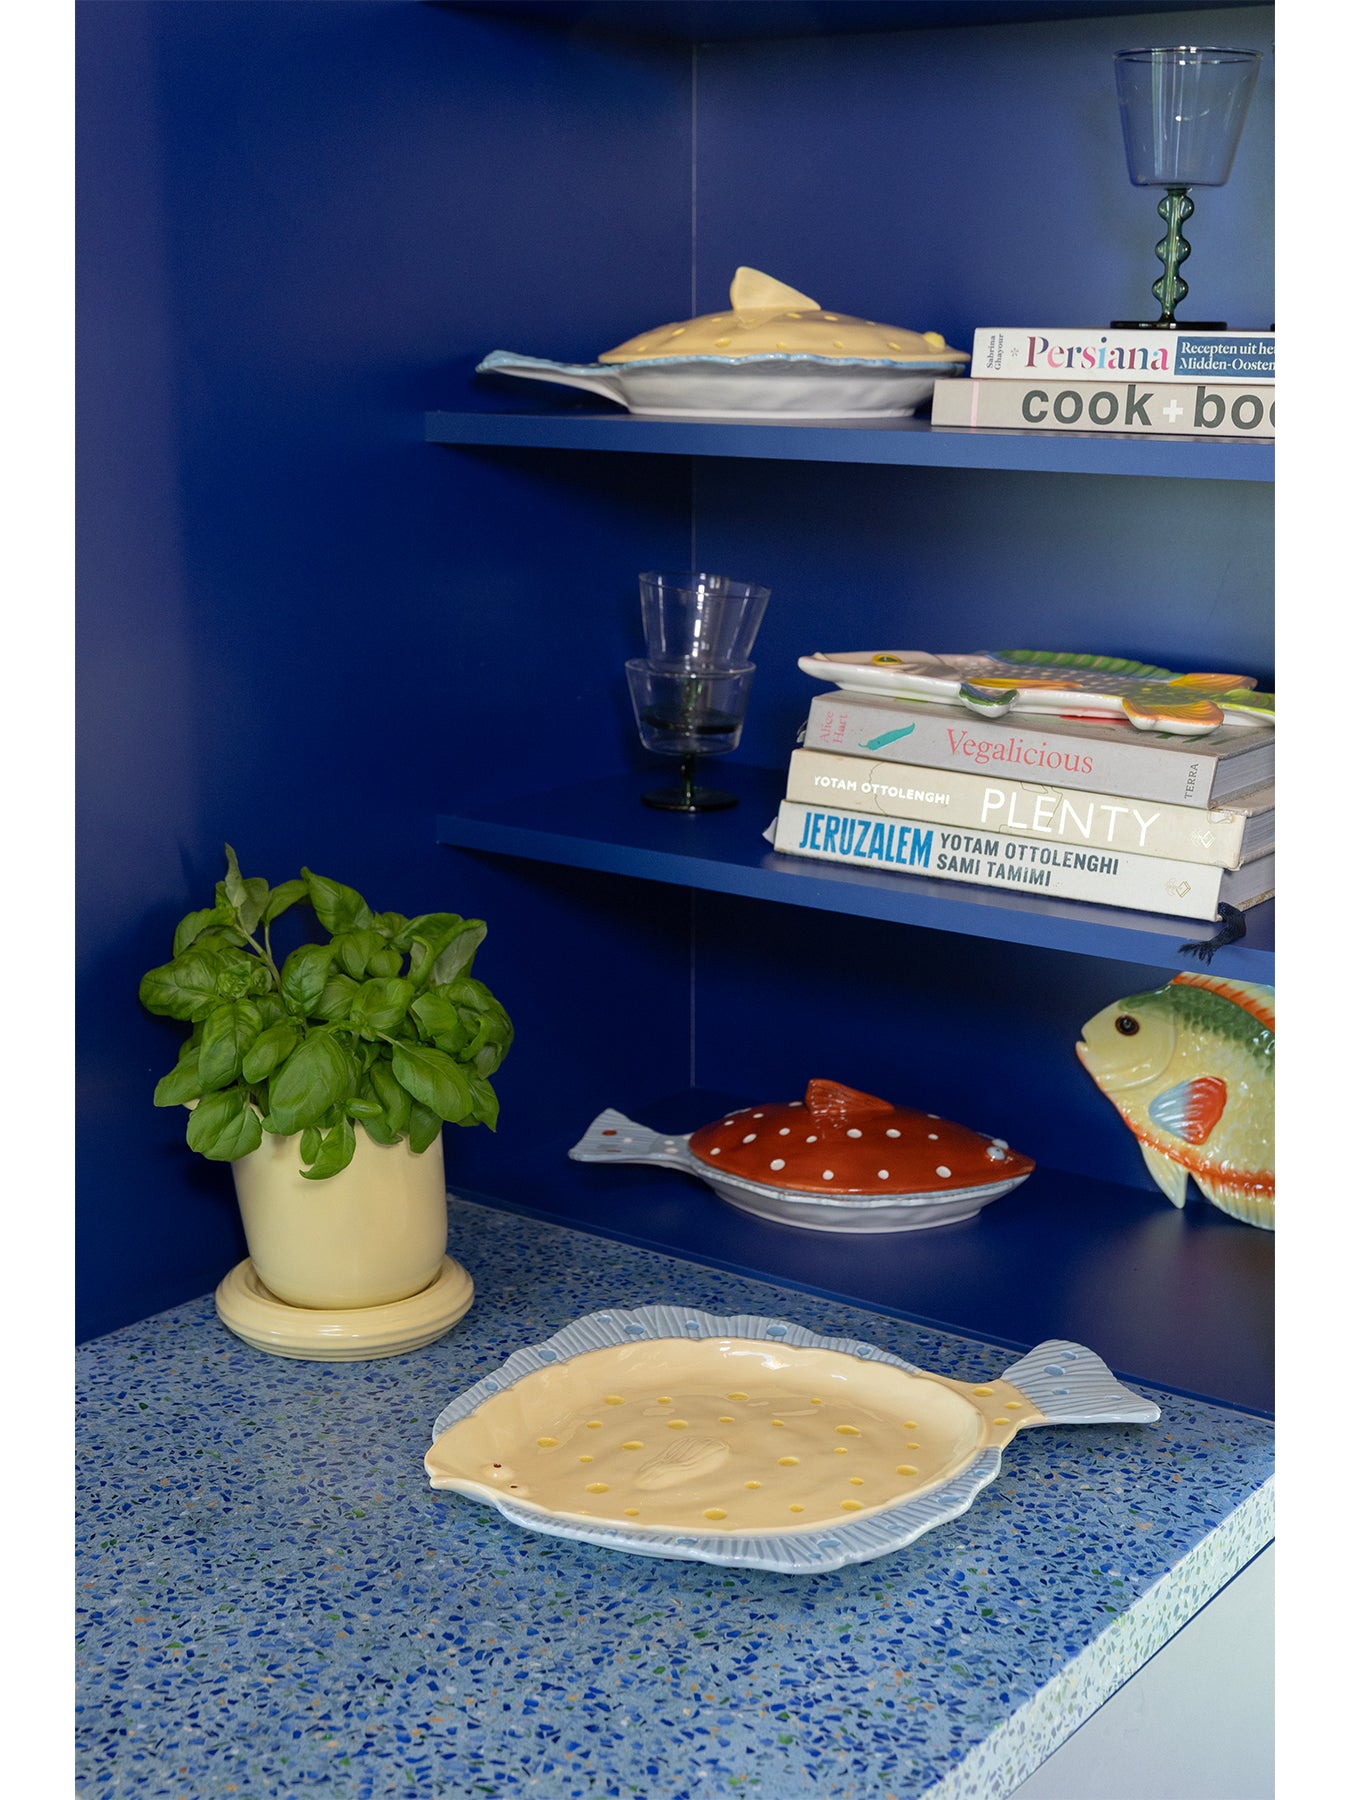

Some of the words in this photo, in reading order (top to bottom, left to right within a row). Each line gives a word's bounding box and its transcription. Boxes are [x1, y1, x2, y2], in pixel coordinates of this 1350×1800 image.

[986, 335, 996, 369] Sabrina
[994, 333, 1005, 371] Ghayour
[1025, 336, 1169, 371] Persiana
[1179, 357, 1275, 371] Midden-Oosten
[1181, 342, 1237, 357] Recepten
[1240, 342, 1257, 354] uit
[1258, 342, 1275, 355] he
[1022, 384, 1155, 426] cook
[1194, 386, 1275, 430] bo
[819, 711, 835, 743] Alice
[832, 714, 848, 744] Hart
[946, 728, 1094, 774] Vegalicious
[813, 775, 857, 792] YOTAM
[861, 782, 951, 805] OTTOLENGHI
[1184, 763, 1199, 799] TERRA
[981, 788, 1160, 847] PLENTY
[799, 811, 934, 868] JERUZALEM
[940, 832, 998, 857] YOTAM
[1004, 842, 1119, 875] OTTOLENGHI
[936, 854, 980, 876] SAMI
[987, 861, 1051, 887] TAMIMI
